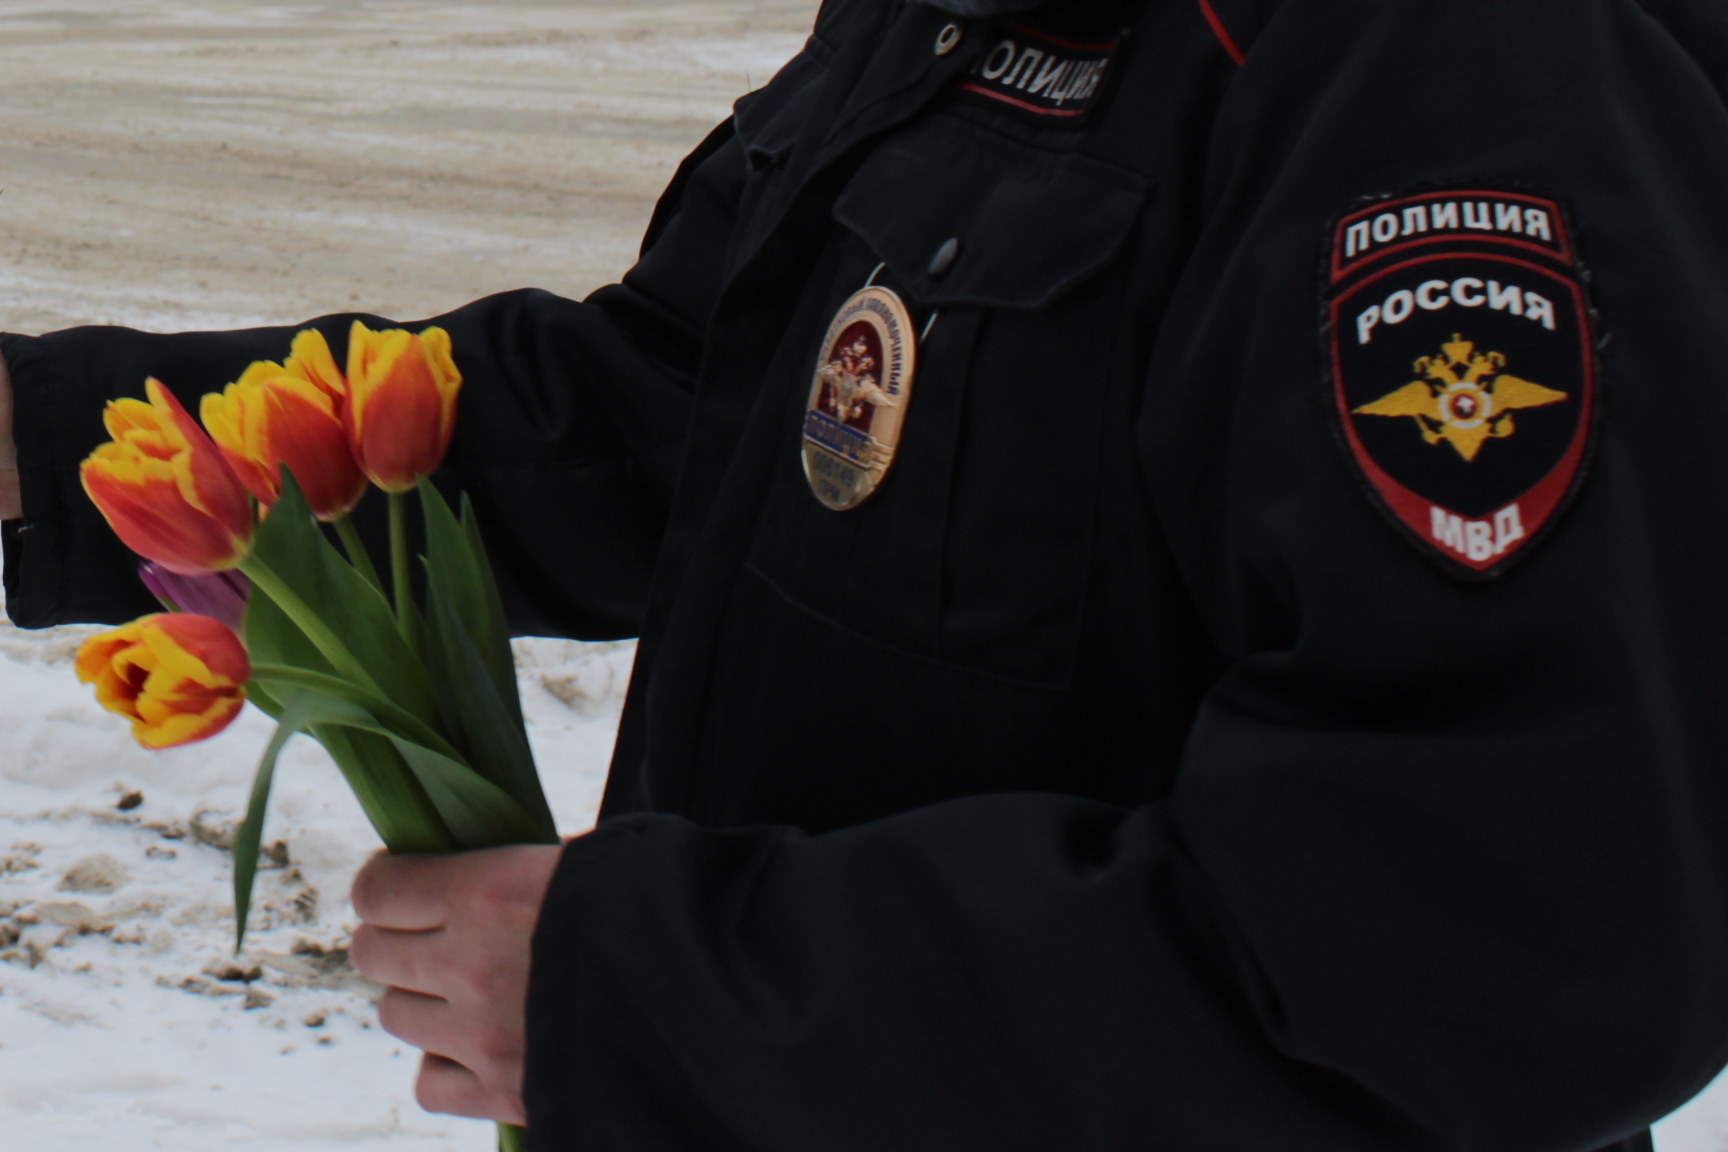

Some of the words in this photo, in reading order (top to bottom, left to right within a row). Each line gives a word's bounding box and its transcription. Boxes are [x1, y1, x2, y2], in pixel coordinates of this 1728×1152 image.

[970, 39, 1109, 106] ОЛИЦИЯ
[1345, 201, 1552, 257] ПОЛИЦИЯ
[1356, 277, 1556, 345] РОССИЯ
[1430, 503, 1525, 561] МВД
